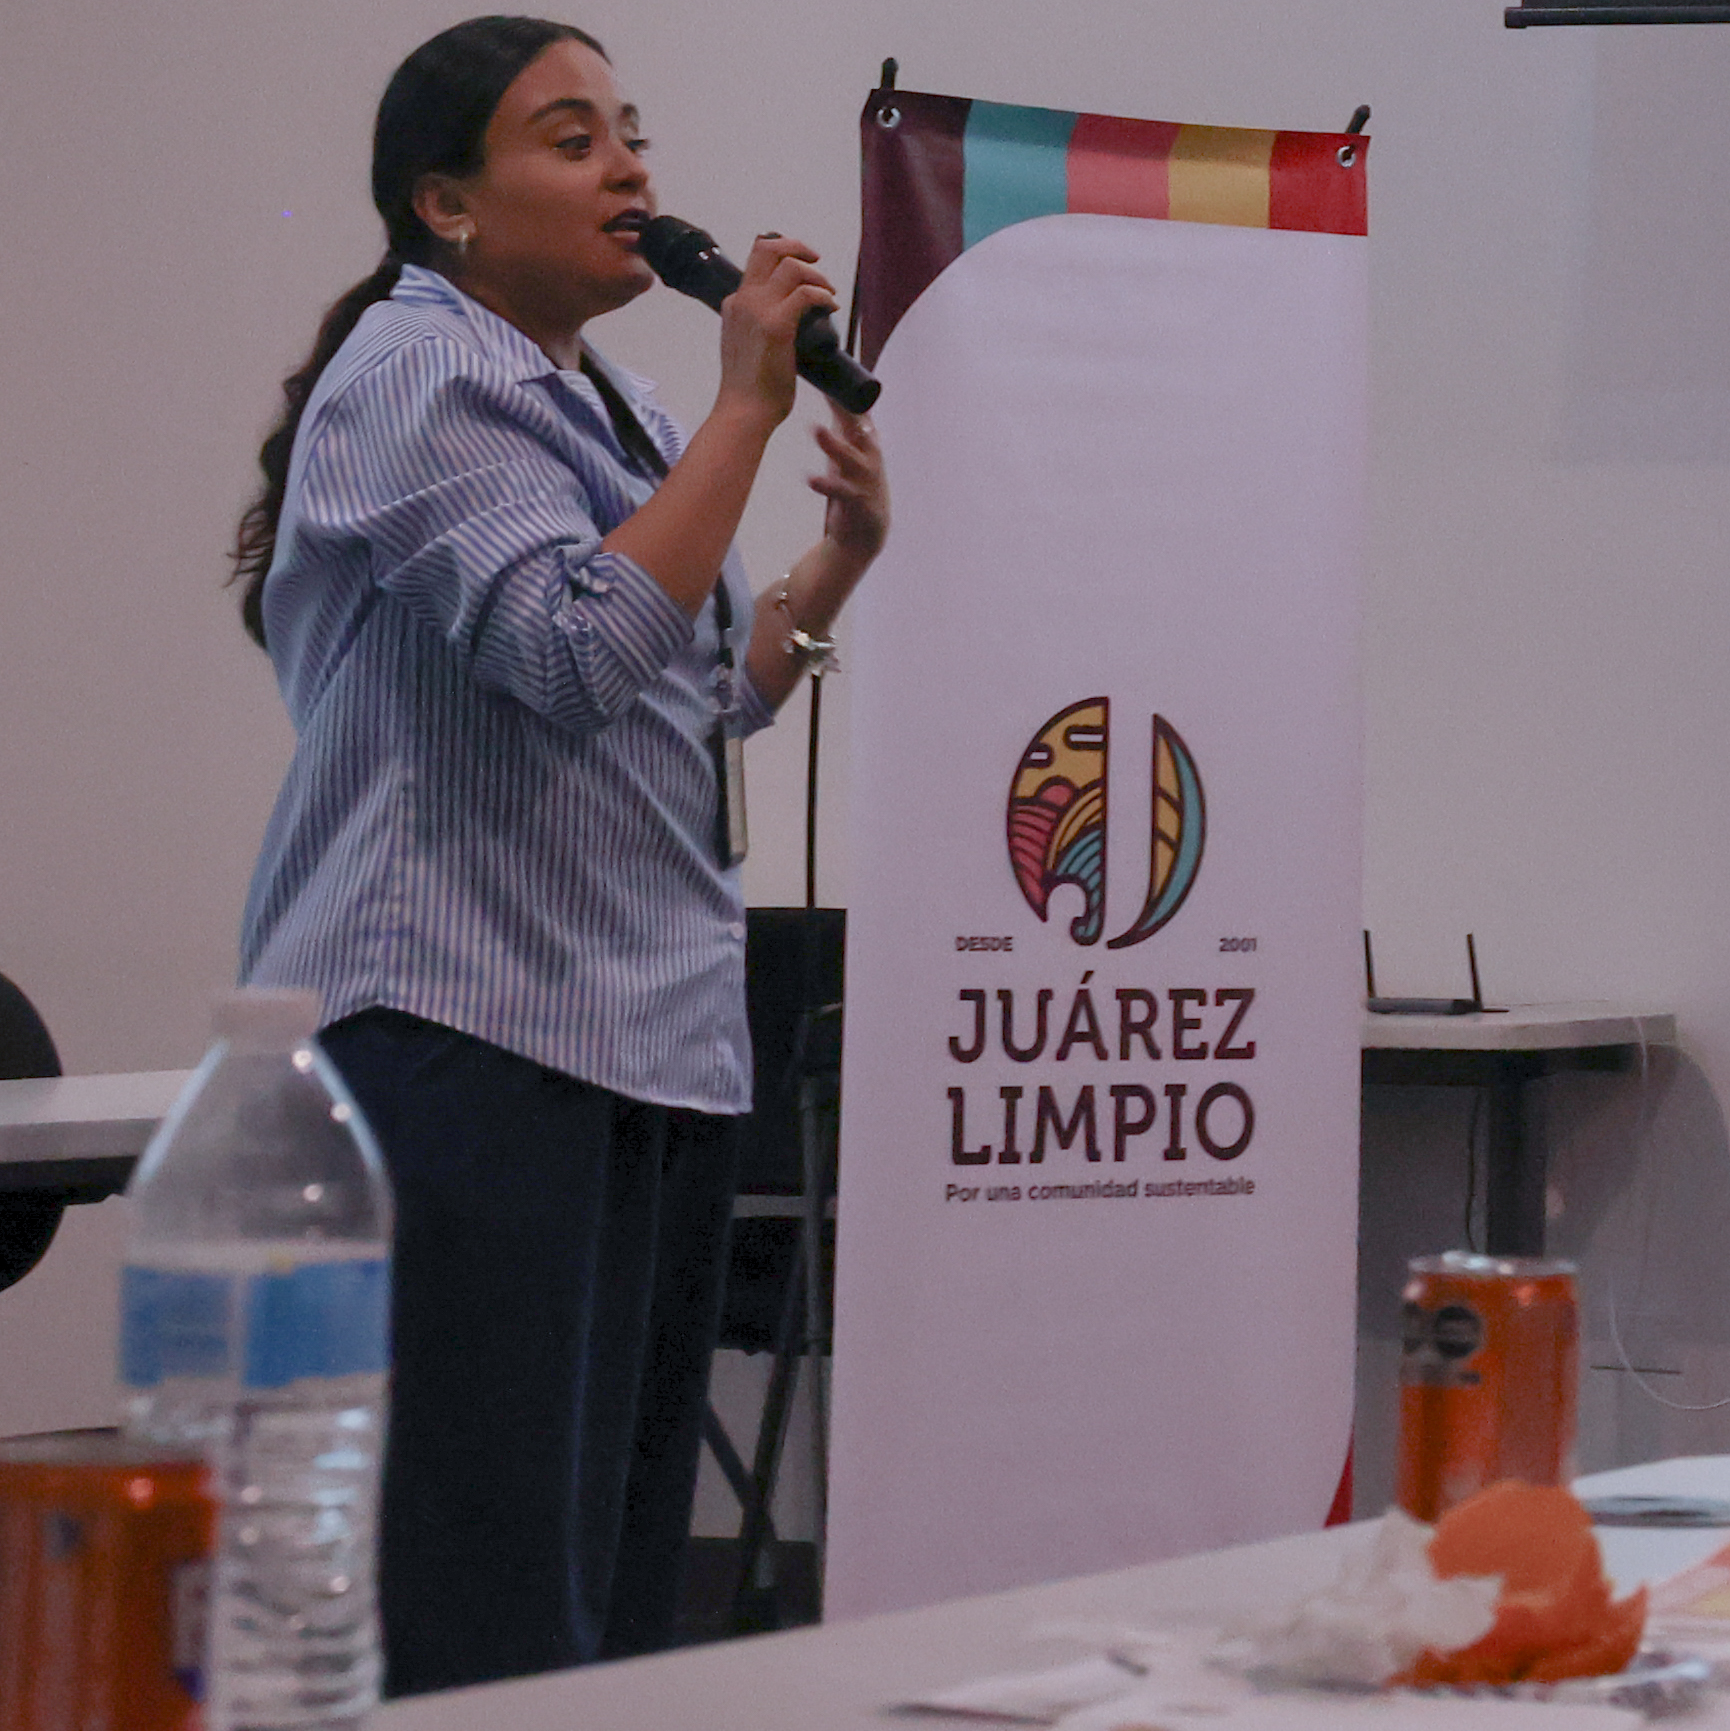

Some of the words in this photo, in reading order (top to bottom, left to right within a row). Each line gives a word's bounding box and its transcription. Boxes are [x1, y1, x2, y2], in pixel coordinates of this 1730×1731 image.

[956, 936, 1013, 951] DESDE
[1219, 937, 1257, 952] 2001
[949, 970, 1255, 1063] JUÁREZ
[948, 1081, 1255, 1165] LIMPIO
[946, 1183, 980, 1201] Por
[987, 1184, 1021, 1201] una
[1028, 1179, 1138, 1200] comunidad
[1145, 1177, 1255, 1197] sustentable
